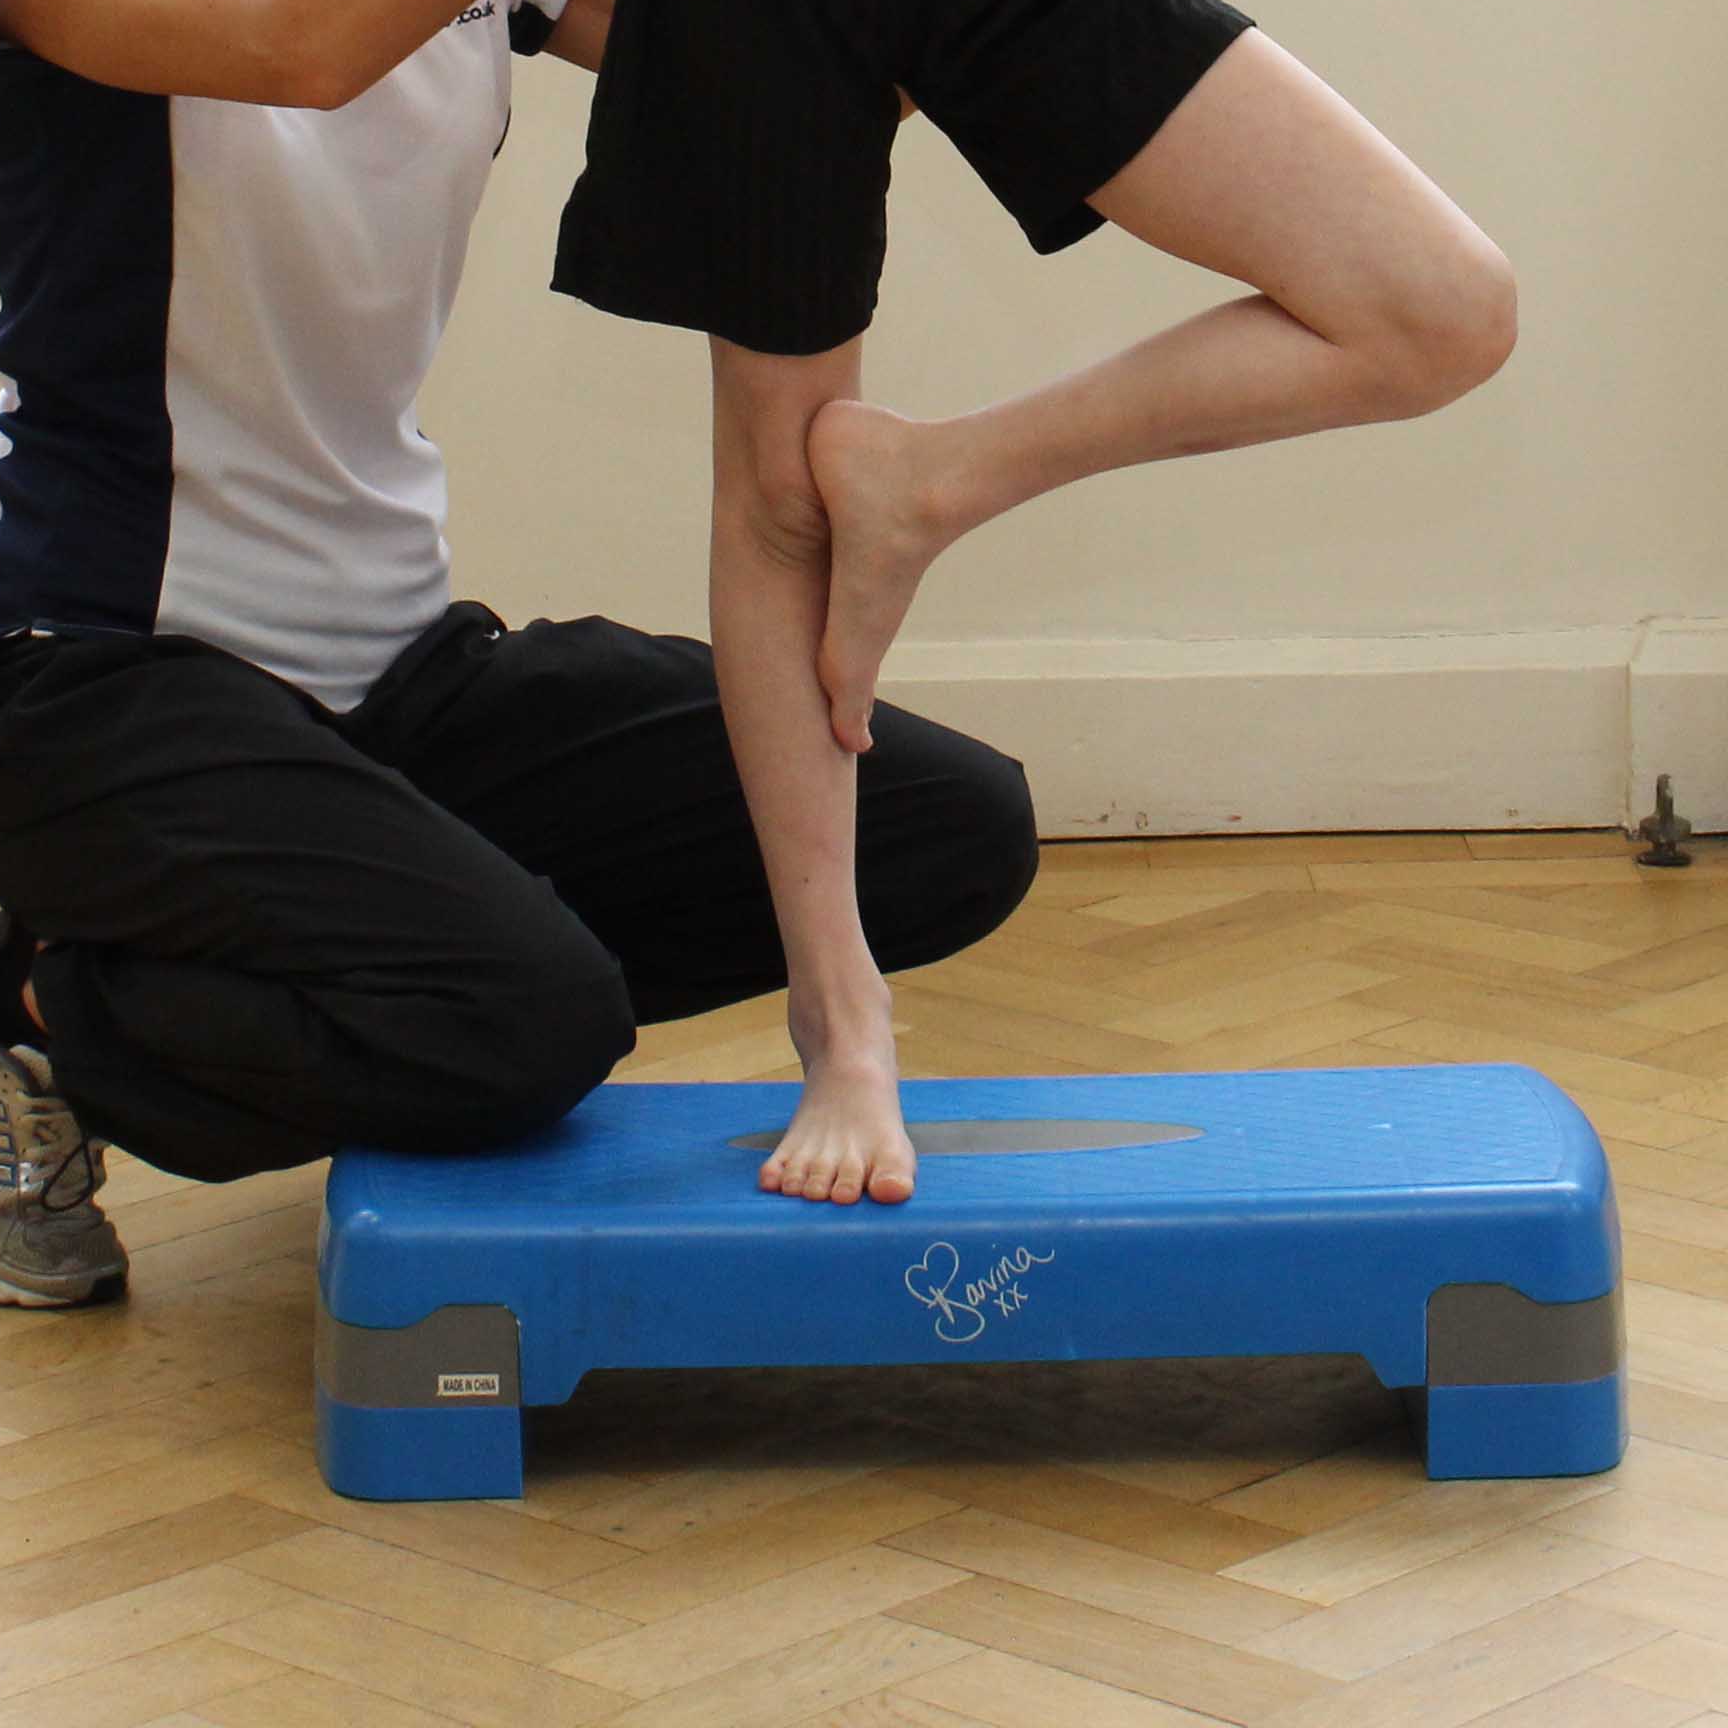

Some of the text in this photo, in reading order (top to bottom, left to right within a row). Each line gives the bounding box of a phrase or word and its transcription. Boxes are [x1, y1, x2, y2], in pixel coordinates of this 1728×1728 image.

[443, 1377, 497, 1392] MADE IN CHINA
